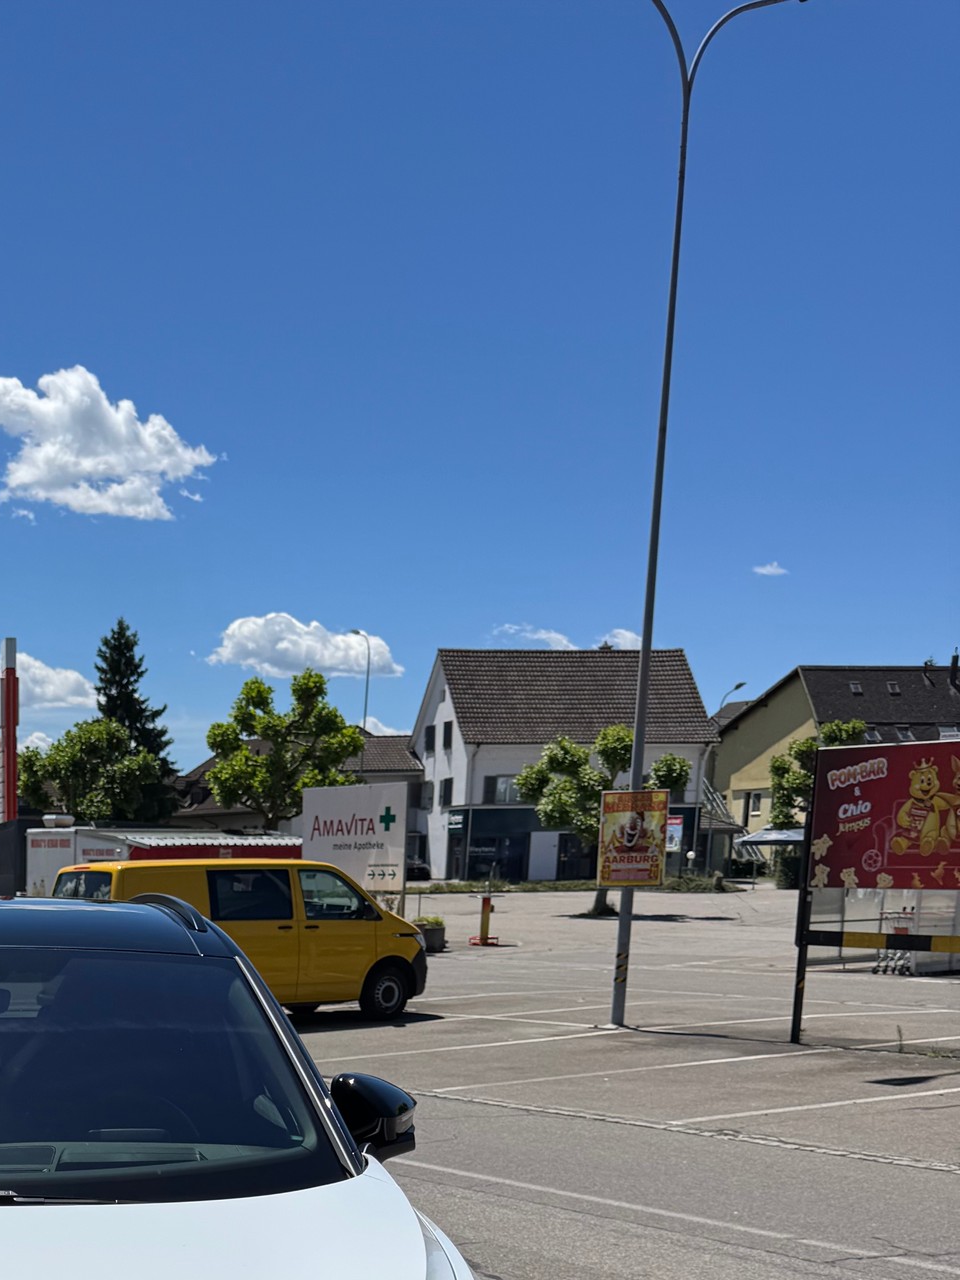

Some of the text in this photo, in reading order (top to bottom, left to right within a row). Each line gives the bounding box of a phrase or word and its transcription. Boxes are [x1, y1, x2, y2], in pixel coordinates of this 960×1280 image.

[854, 786, 862, 797] &
[838, 800, 872, 819] Chio
[332, 840, 385, 852] meine Apotheke
[603, 854, 659, 865] AARBURG
